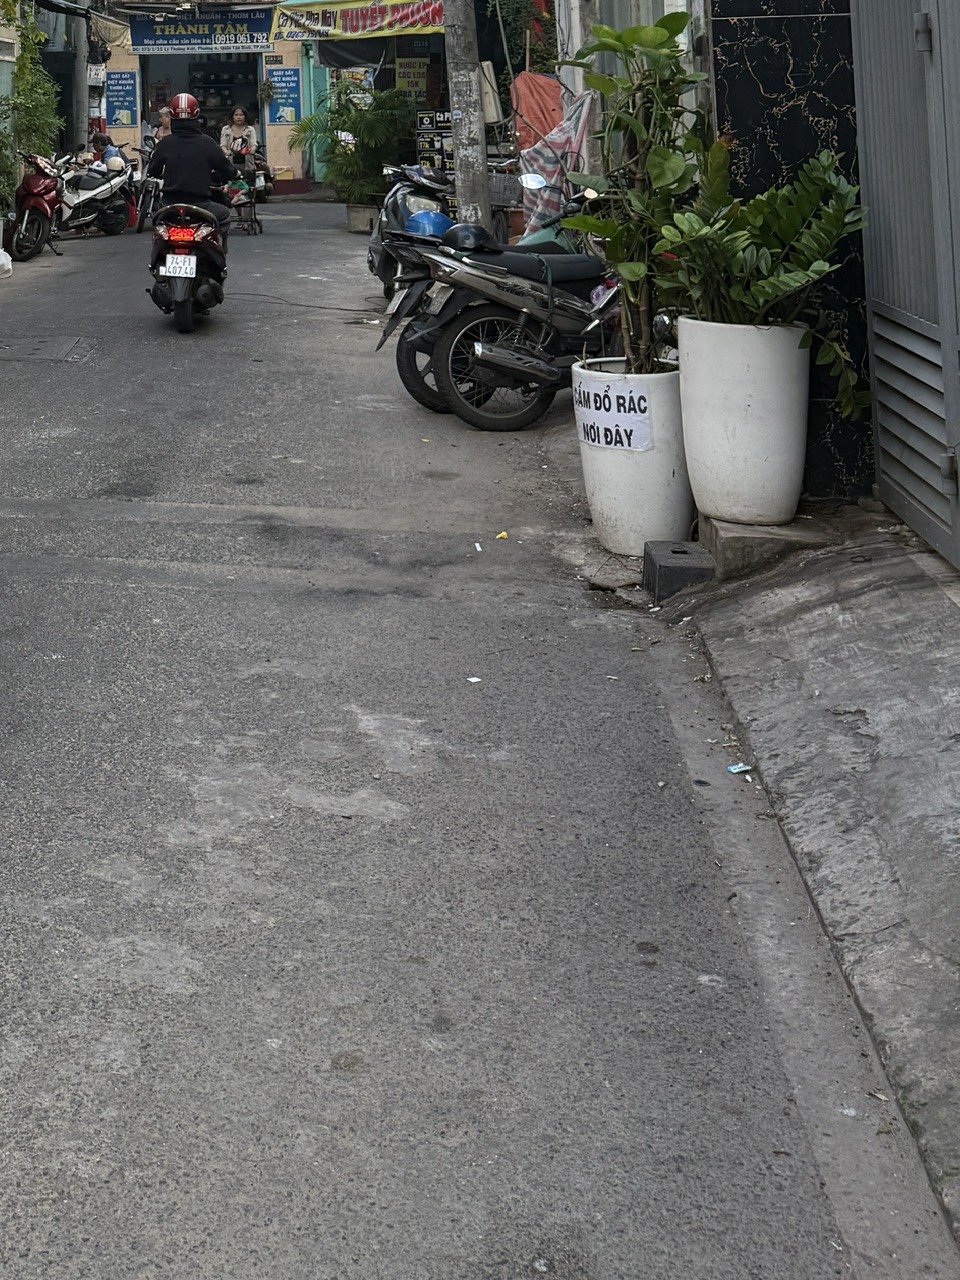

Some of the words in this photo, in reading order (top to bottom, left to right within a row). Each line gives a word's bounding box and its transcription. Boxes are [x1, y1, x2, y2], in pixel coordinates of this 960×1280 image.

[153, 22, 210, 35] THÀNH
[213, 21, 248, 35] TÂM
[215, 34, 235, 44] 0919
[236, 33, 250, 43] 061
[252, 33, 267, 43] 792
[593, 385, 611, 412] ĐỔ
[616, 390, 648, 414] RÁC
[582, 422, 600, 444] NƠI
[603, 424, 633, 447] ĐÂY
